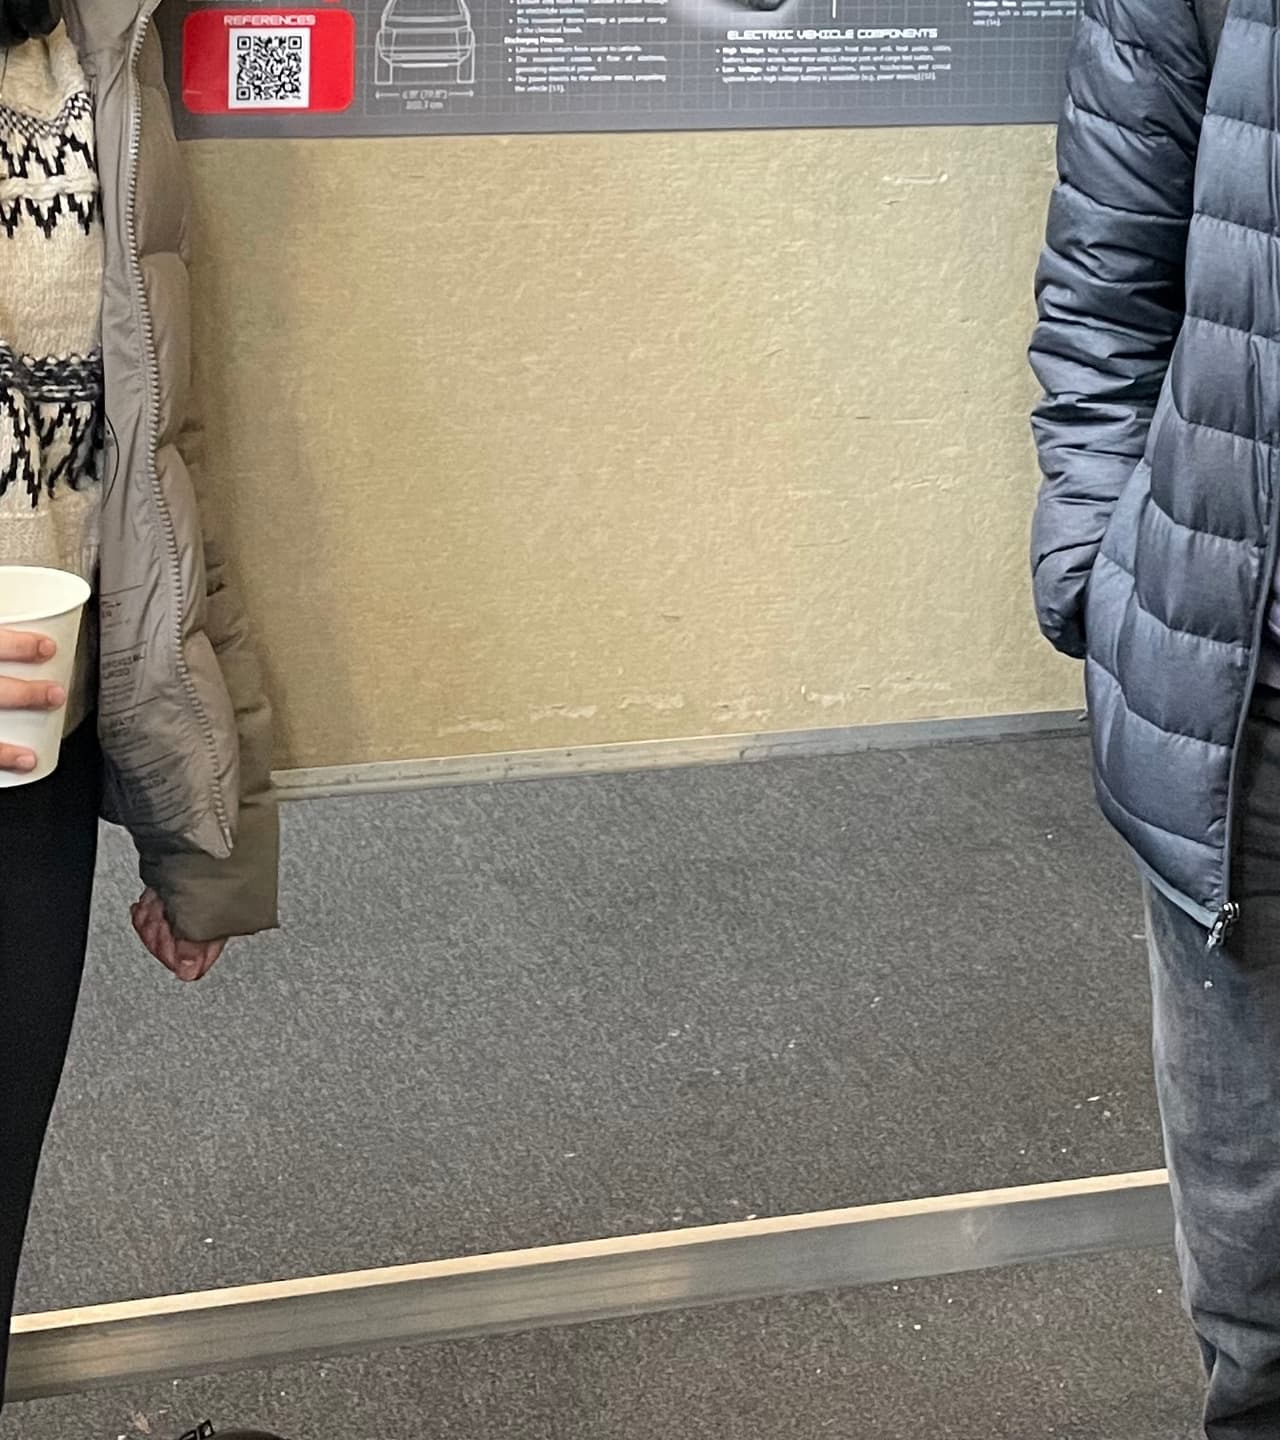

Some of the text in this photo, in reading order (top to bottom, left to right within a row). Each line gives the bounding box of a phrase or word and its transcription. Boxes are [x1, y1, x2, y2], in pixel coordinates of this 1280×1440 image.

[224, 14, 316, 27] REFERENCES
[726, 27, 938, 41] ELECTRIC VEHICLE COMPONENTS
